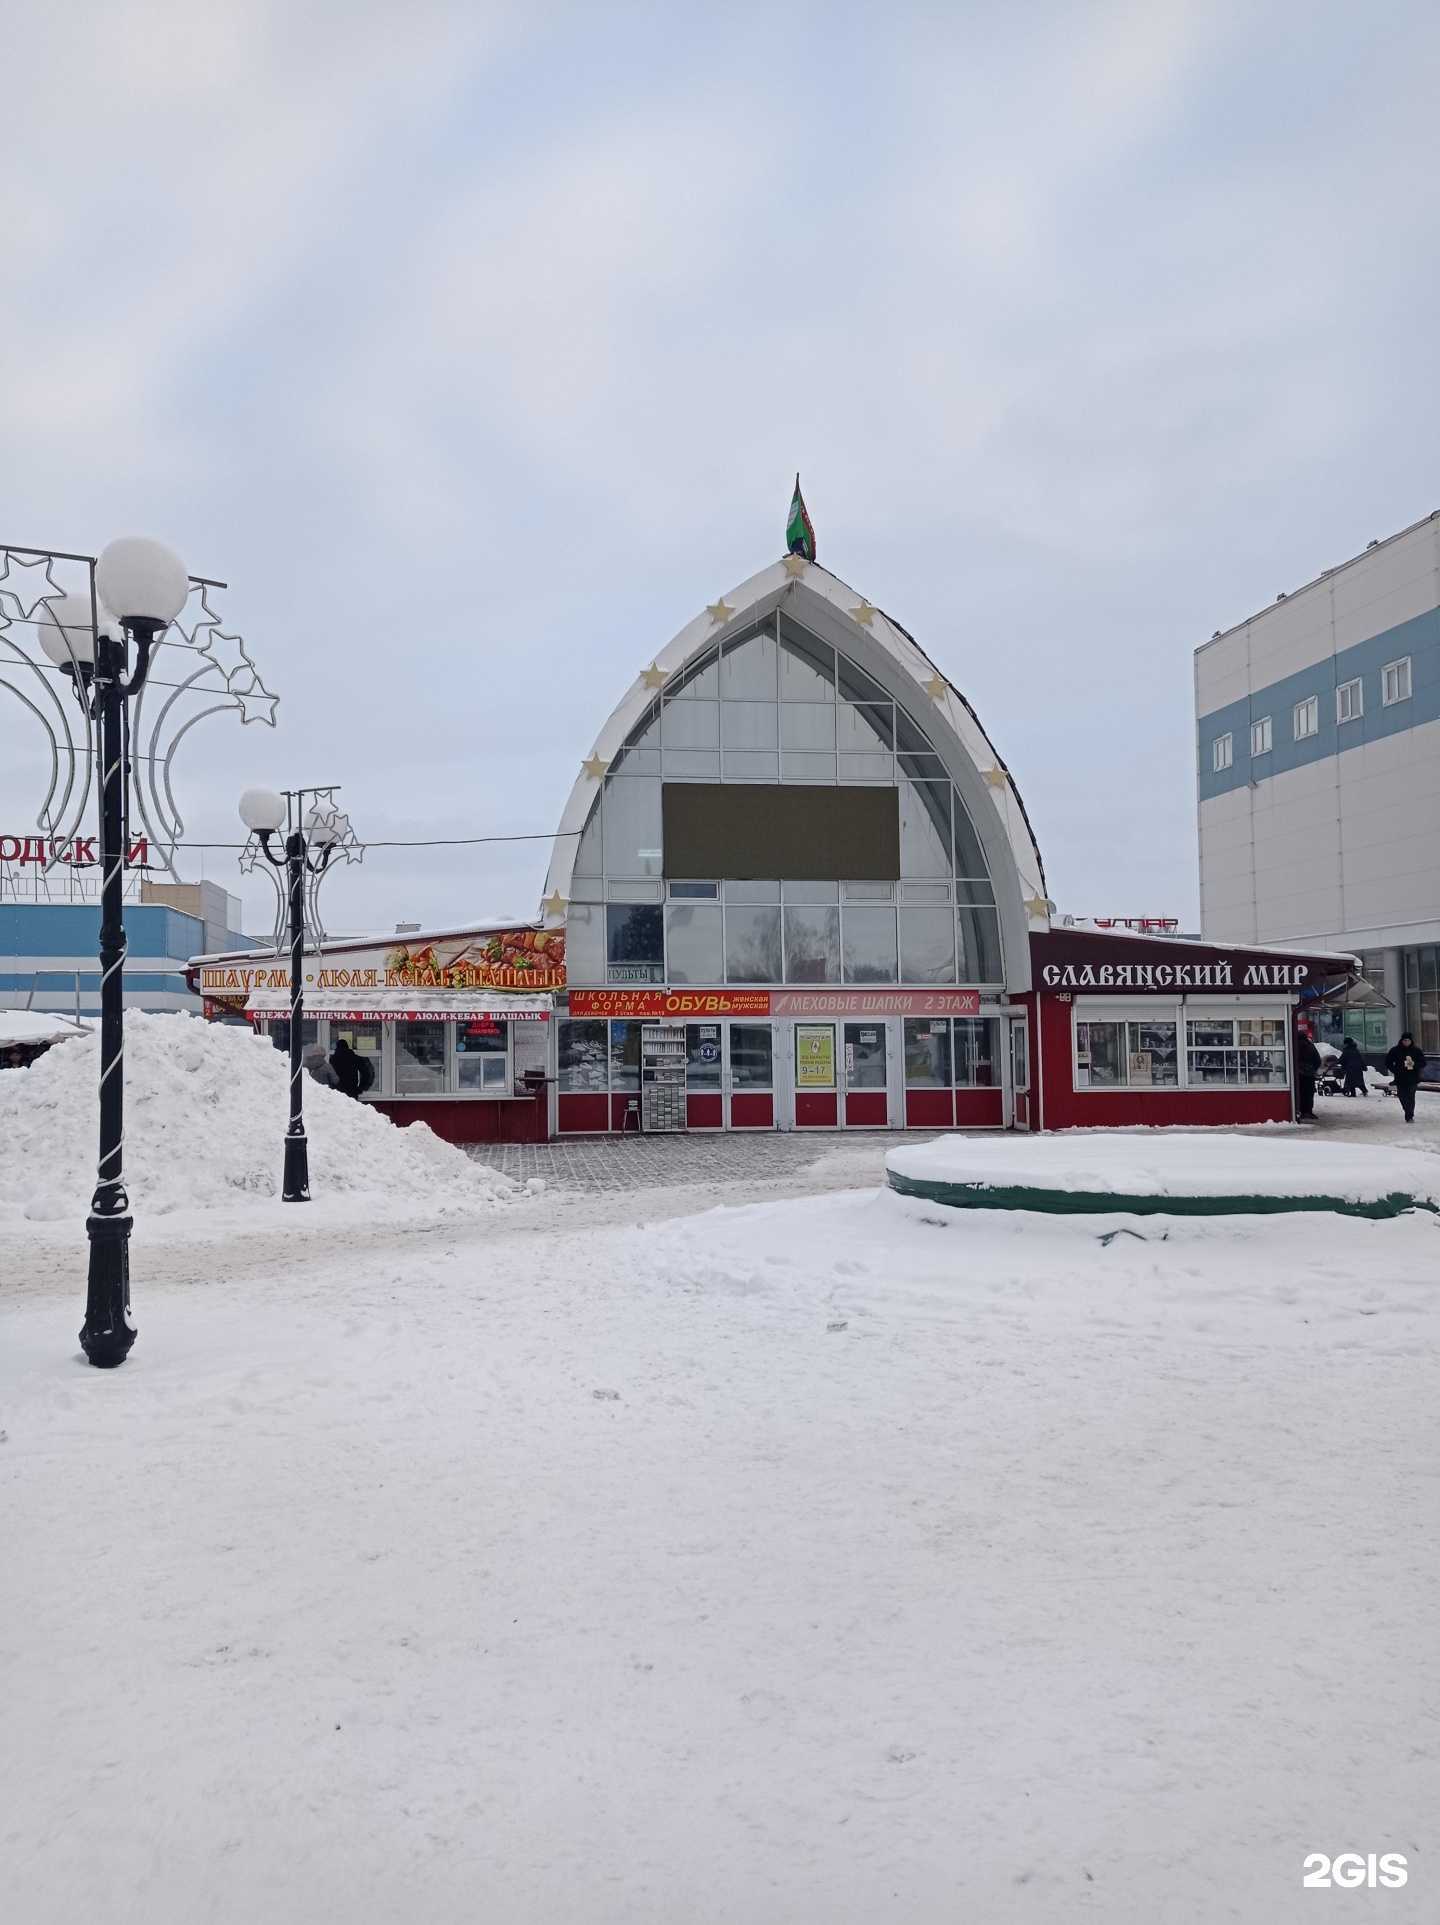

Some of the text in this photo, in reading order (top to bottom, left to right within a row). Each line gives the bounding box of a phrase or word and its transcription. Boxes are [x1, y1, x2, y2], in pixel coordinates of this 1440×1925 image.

[0, 831, 148, 867] ОДСКЙ
[202, 969, 295, 992] ШАУРМ
[464, 967, 563, 986] ШАШЛЫК
[608, 967, 648, 980] ПУЛЬТЫ
[1042, 960, 1309, 987] СЛАВЯНСКИЙ МИР
[574, 991, 663, 1001] ШКОЛЬНАЯ
[666, 995, 732, 1011] ОБУВЬ
[789, 995, 858, 1010] МЕХОВЫЕ
[861, 995, 913, 1010] ШАПКИ
[924, 996, 934, 1009] 2
[937, 995, 974, 1009] ЭТАЖ
[591, 1001, 646, 1011] ФОРМА
[252, 1011, 296, 1021] СВЕЖА
[303, 1011, 356, 1021] ВЫПЕЧКА
[361, 1012, 409, 1021] ШАУРМА
[489, 1012, 542, 1021] ШАШЛЫК
